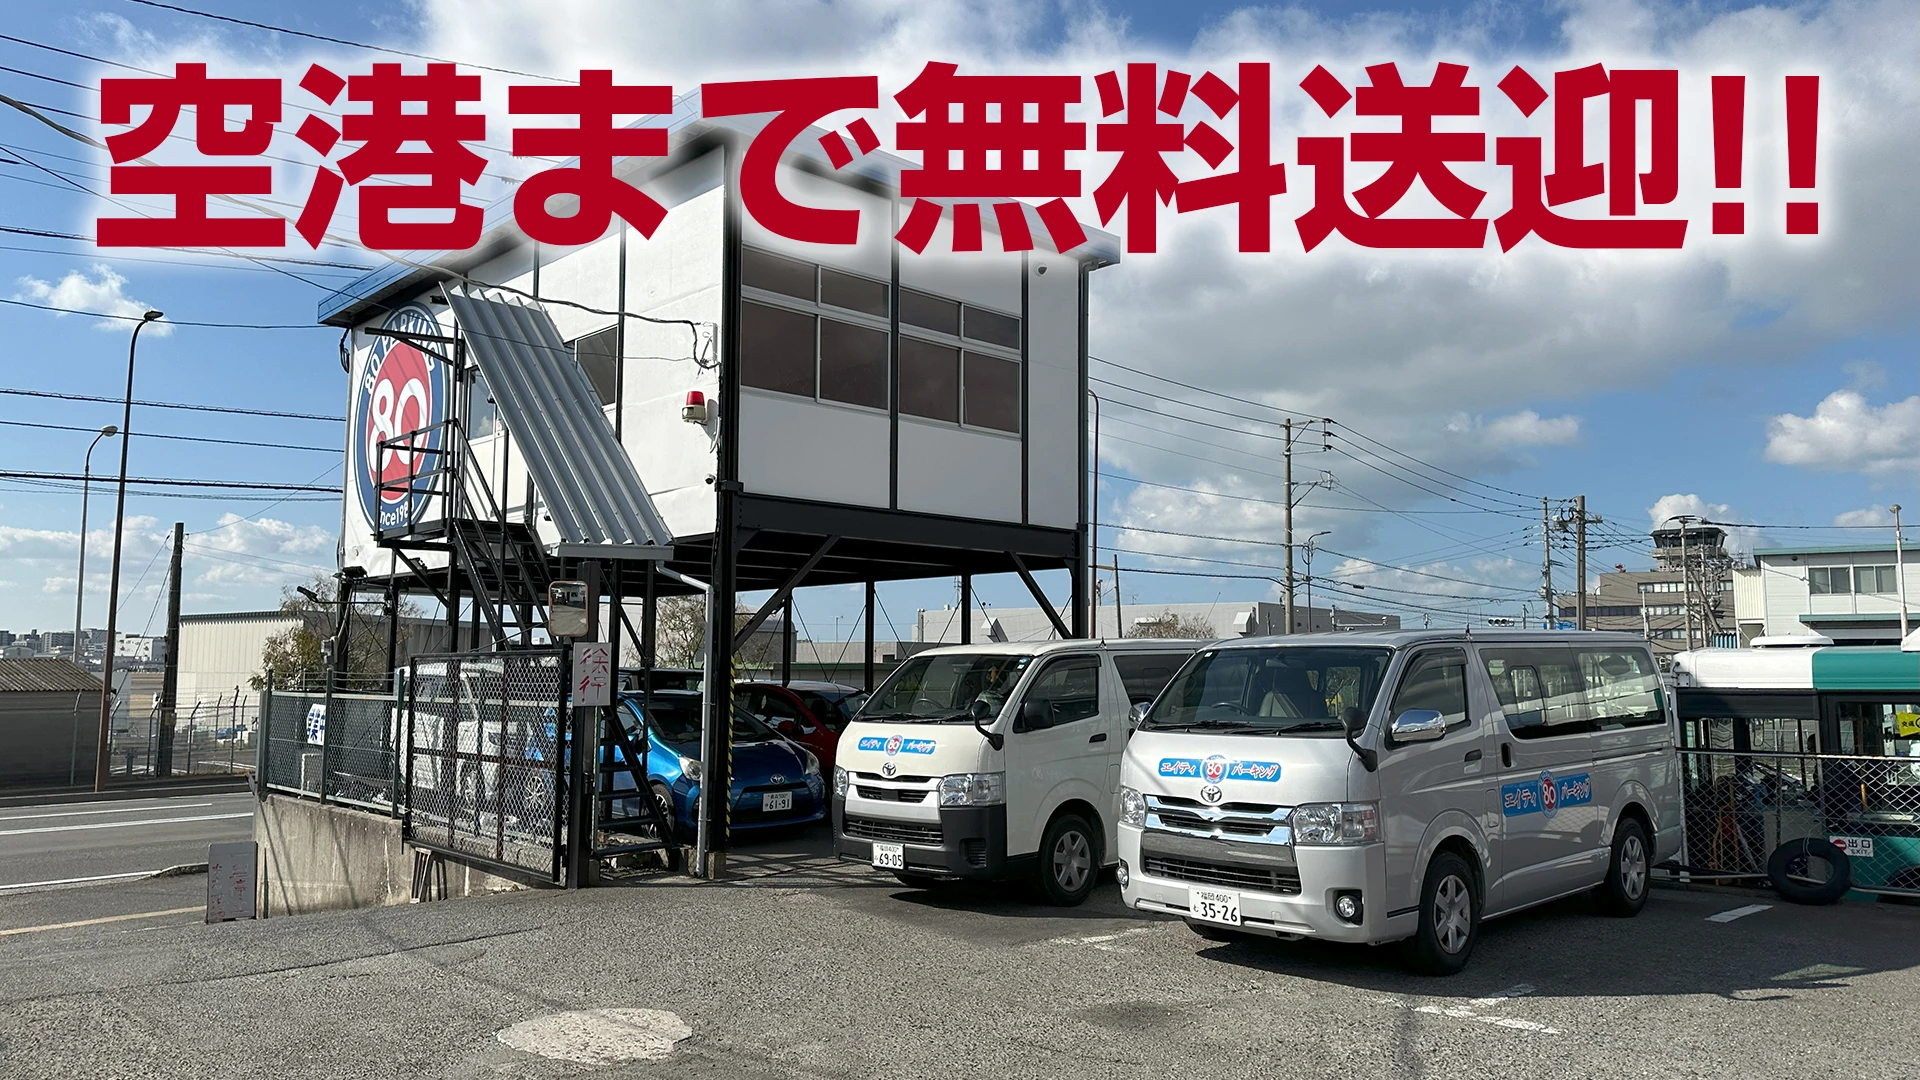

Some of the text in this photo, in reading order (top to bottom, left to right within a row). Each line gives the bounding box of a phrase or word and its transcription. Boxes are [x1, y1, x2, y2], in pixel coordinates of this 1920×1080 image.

[368, 377, 428, 473] 80
[578, 648, 609, 703] 徐行
[1160, 761, 1279, 779] エイティ 80 パーキング
[1504, 788, 1537, 809] エイティ
[1542, 783, 1556, 805] 80
[1848, 839, 1871, 848] 出口
[1200, 902, 1238, 923] 35-26
